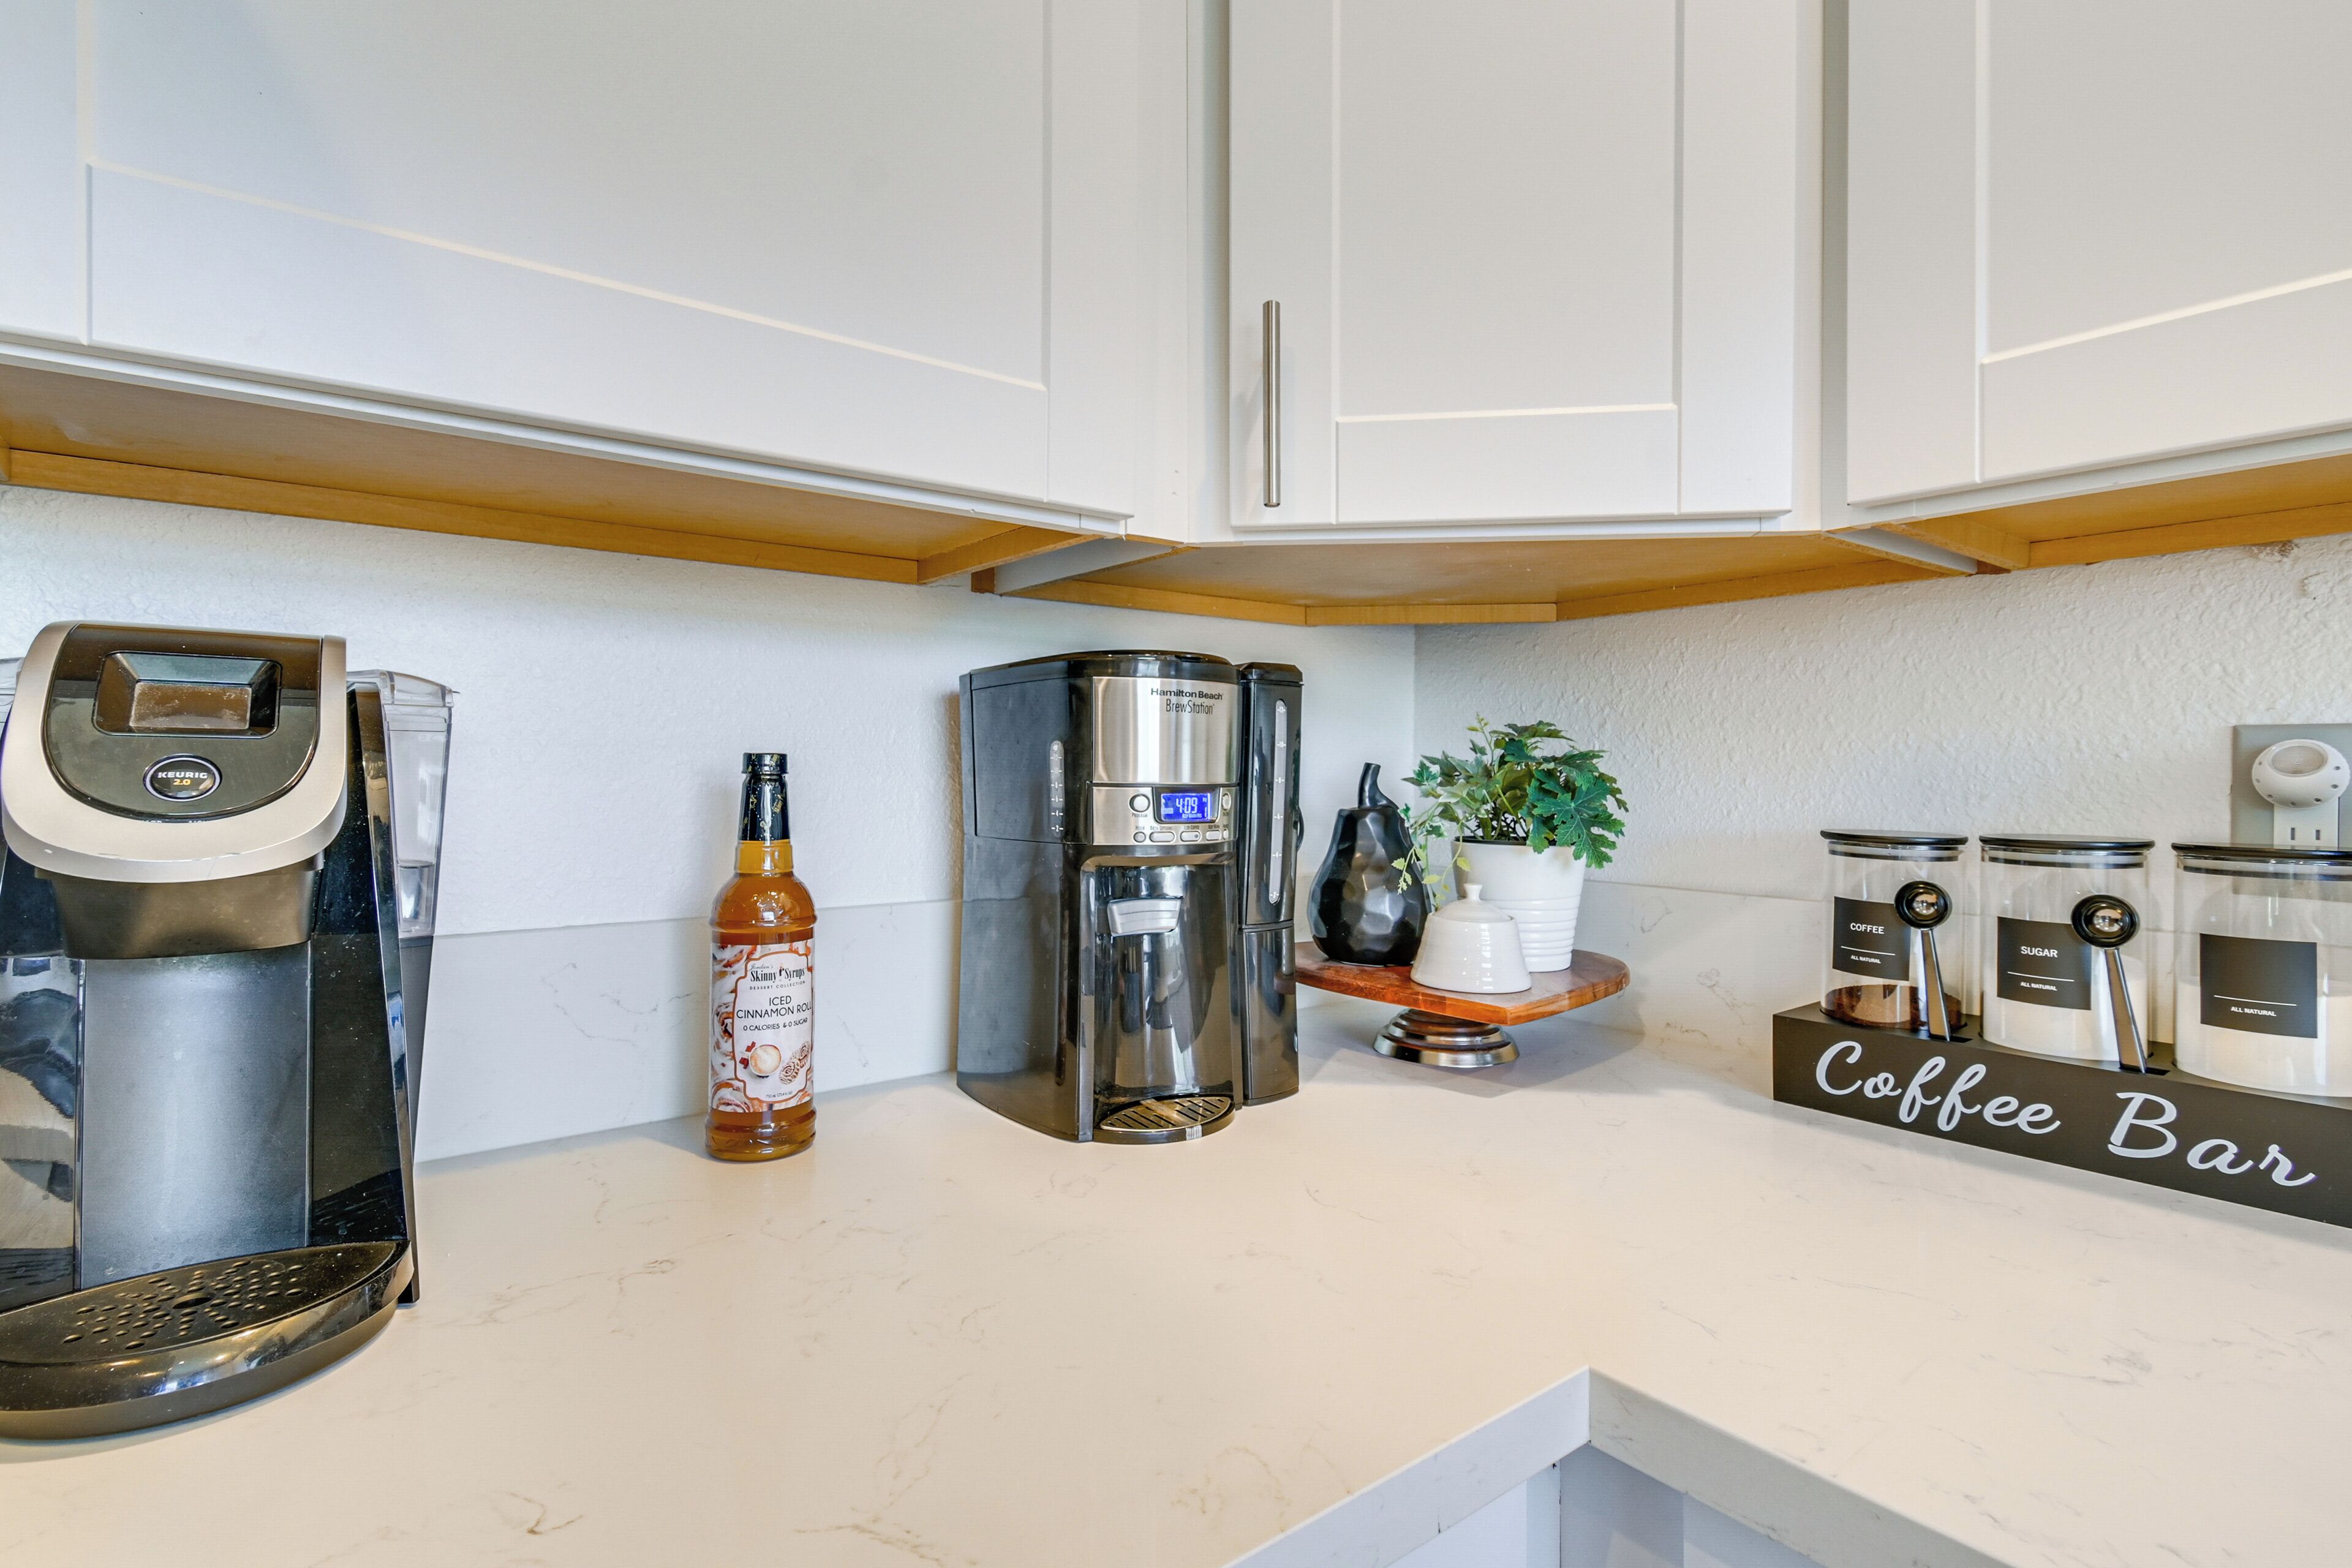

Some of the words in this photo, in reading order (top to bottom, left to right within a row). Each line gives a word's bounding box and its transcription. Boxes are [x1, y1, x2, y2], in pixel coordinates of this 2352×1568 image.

[1150, 688, 1197, 698] Hamilton
[1197, 690, 1223, 701] Beach
[1166, 698, 1213, 715] BrewStation
[1175, 797, 1198, 815] 4:09
[1850, 922, 1885, 935] COFFEE
[2020, 946, 2058, 958] SUGAR
[750, 970, 777, 984] Skinny
[784, 967, 805, 981] Syrups
[775, 980, 805, 989] COLLECTION
[2030, 982, 2058, 992] NATURAL
[769, 995, 792, 1006] ICED
[736, 1005, 794, 1019] CINNAMON
[796, 1000, 812, 1014] ROLL
[2244, 1008, 2278, 1017] NATURAL
[749, 1023, 780, 1031] CALORIES
[793, 1017, 809, 1027] SUGAR
[1815, 1040, 2061, 1134] Coffee
[2108, 1091, 2316, 1187] Bar
